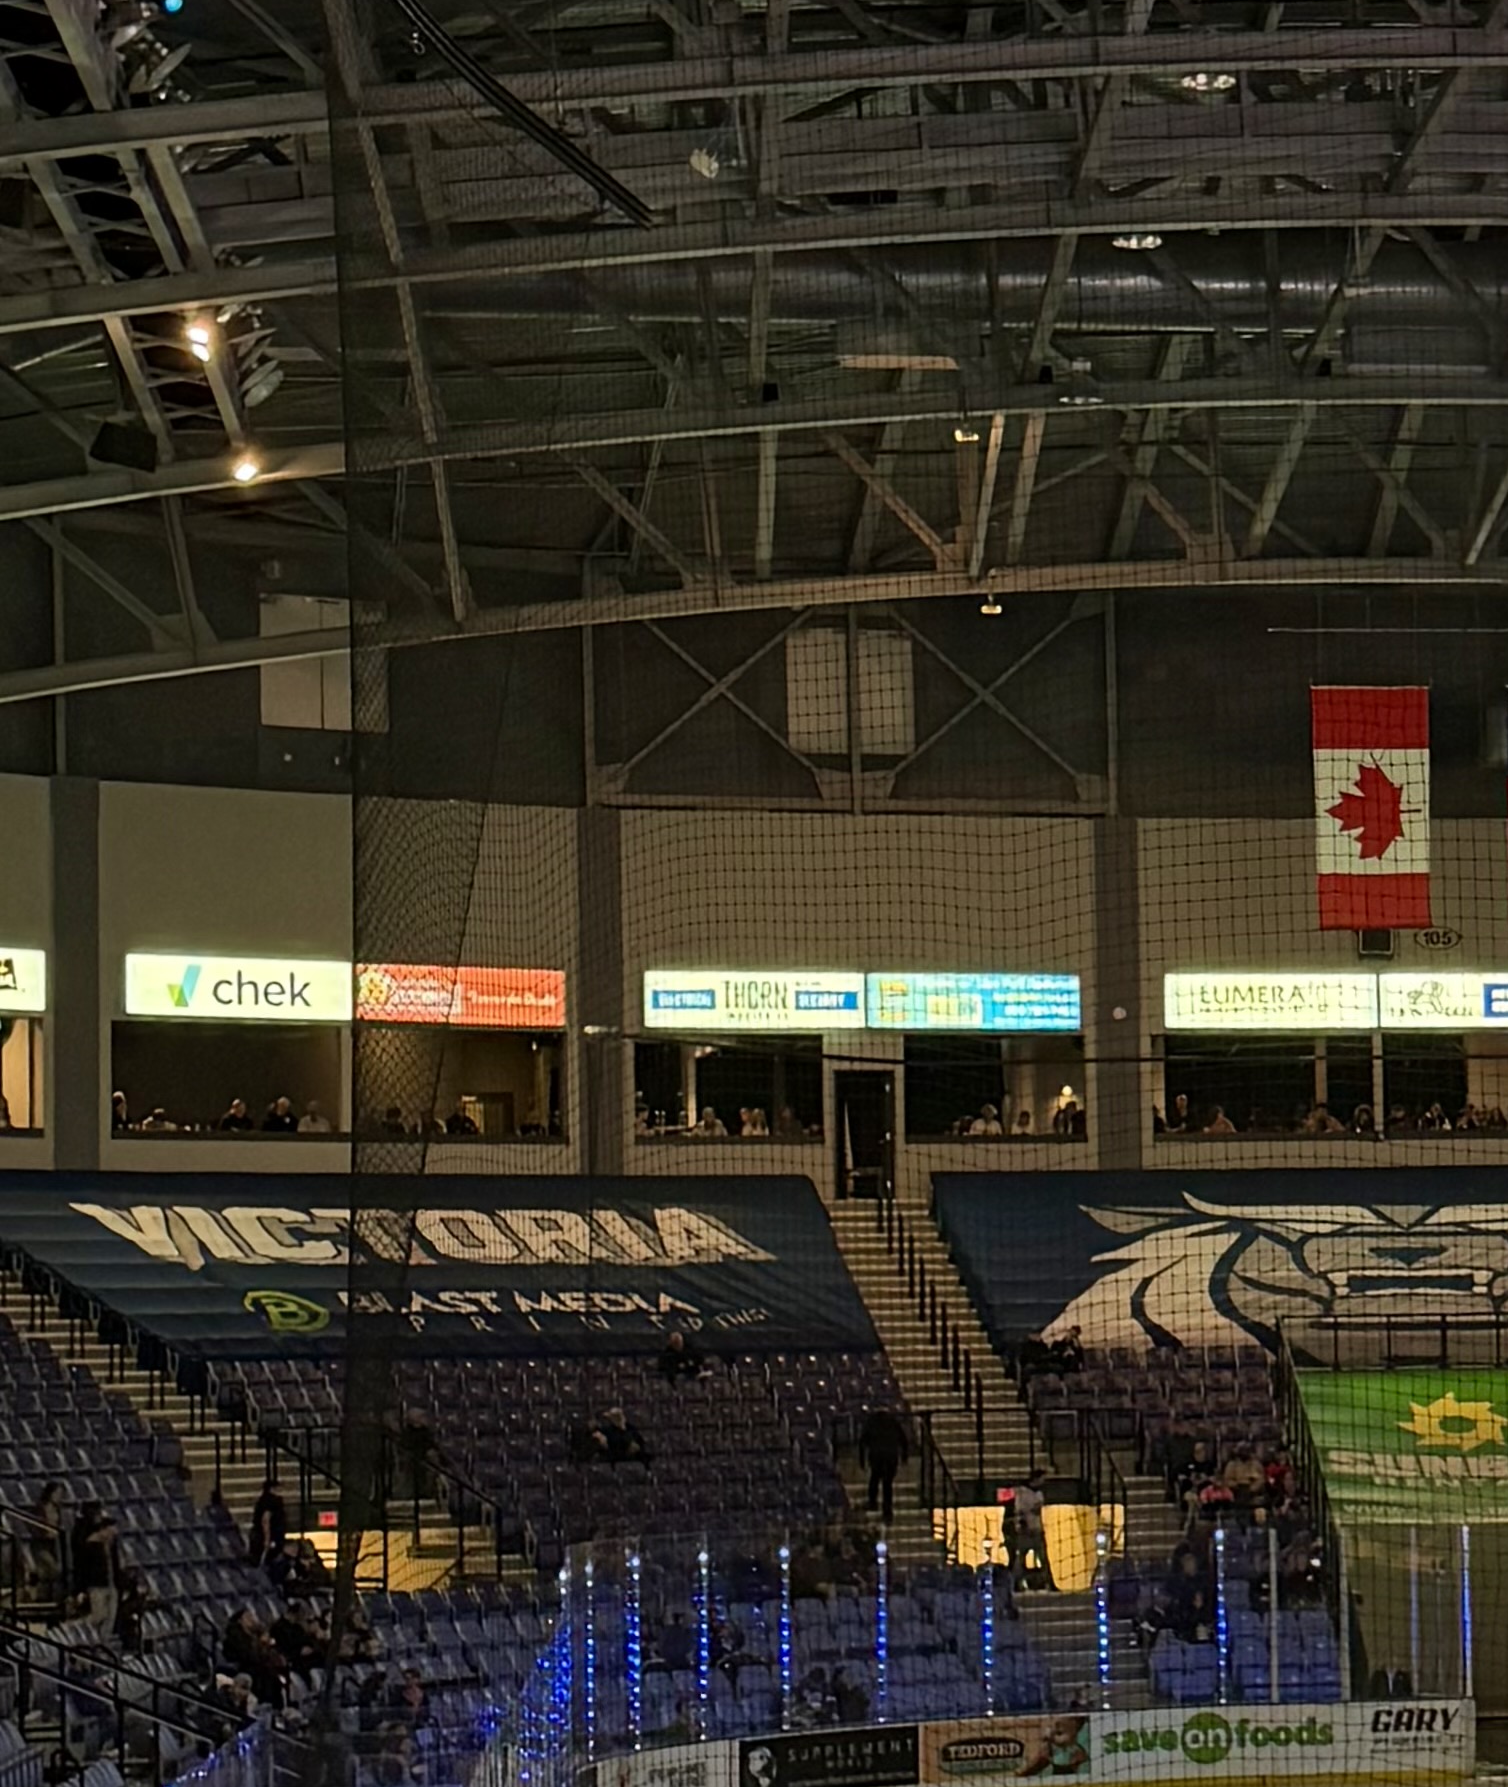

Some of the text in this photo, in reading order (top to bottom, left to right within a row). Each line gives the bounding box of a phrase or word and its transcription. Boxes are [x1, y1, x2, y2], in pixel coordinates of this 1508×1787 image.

[1423, 931, 1452, 946] 105
[213, 969, 312, 1007] chek
[724, 980, 788, 1010] THORN
[69, 1201, 778, 1271] VICTORIA
[512, 1289, 702, 1314] MEDIA
[1371, 1707, 1460, 1734] GARY
[788, 1738, 914, 1762] SUPPLEMENT
